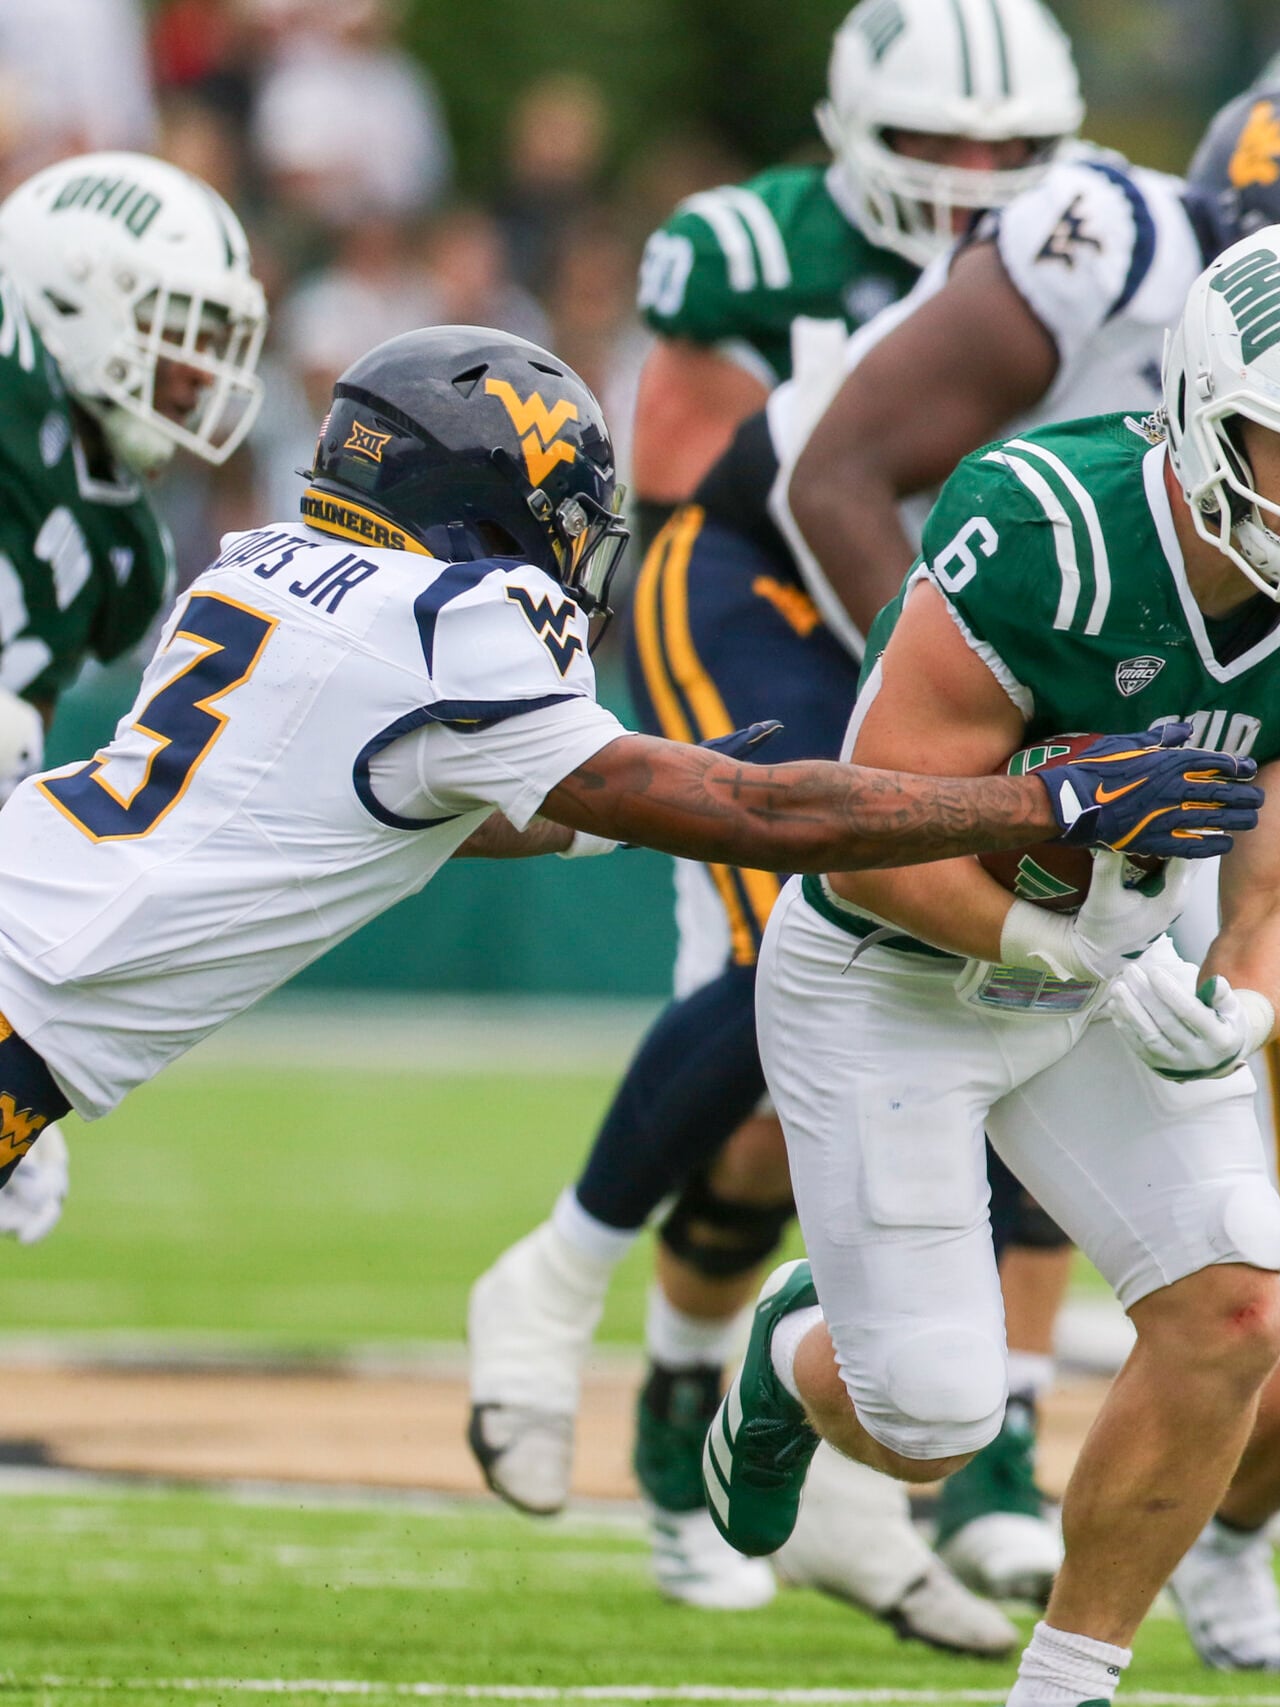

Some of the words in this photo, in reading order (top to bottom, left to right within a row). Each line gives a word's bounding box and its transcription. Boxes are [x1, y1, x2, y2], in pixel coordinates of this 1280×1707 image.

[207, 531, 321, 579] OATS
[289, 553, 379, 614] JR
[933, 516, 999, 593] 6
[1119, 668, 1156, 679] MAC
[34, 590, 280, 844] 3
[1148, 710, 1262, 757] HIO
